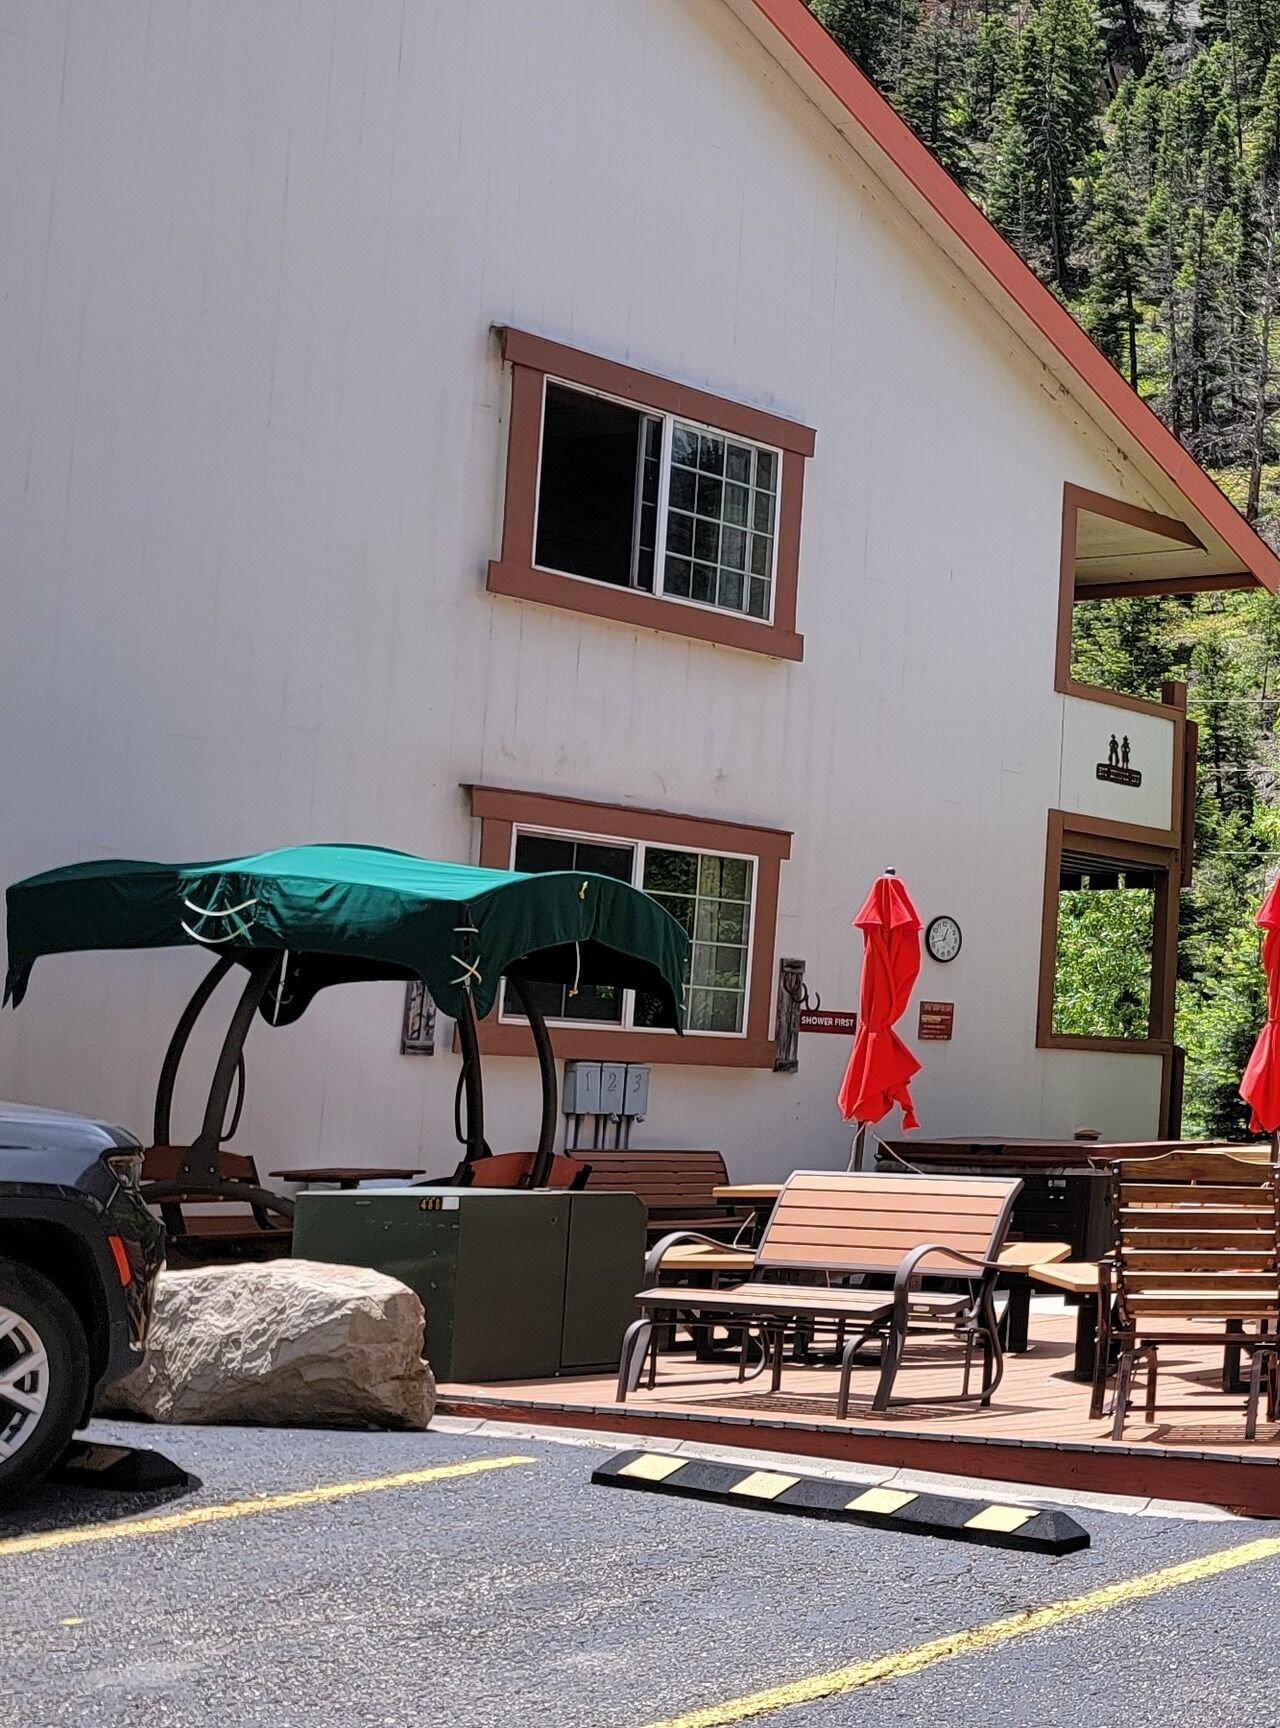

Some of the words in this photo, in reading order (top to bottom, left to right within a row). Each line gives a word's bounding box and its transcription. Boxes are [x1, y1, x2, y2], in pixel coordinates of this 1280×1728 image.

[801, 1015, 833, 1026] SHOWER
[834, 1018, 854, 1027] FIRST
[585, 1071, 591, 1092] 1
[607, 1072, 617, 1092] 2
[633, 1074, 642, 1093] 3
